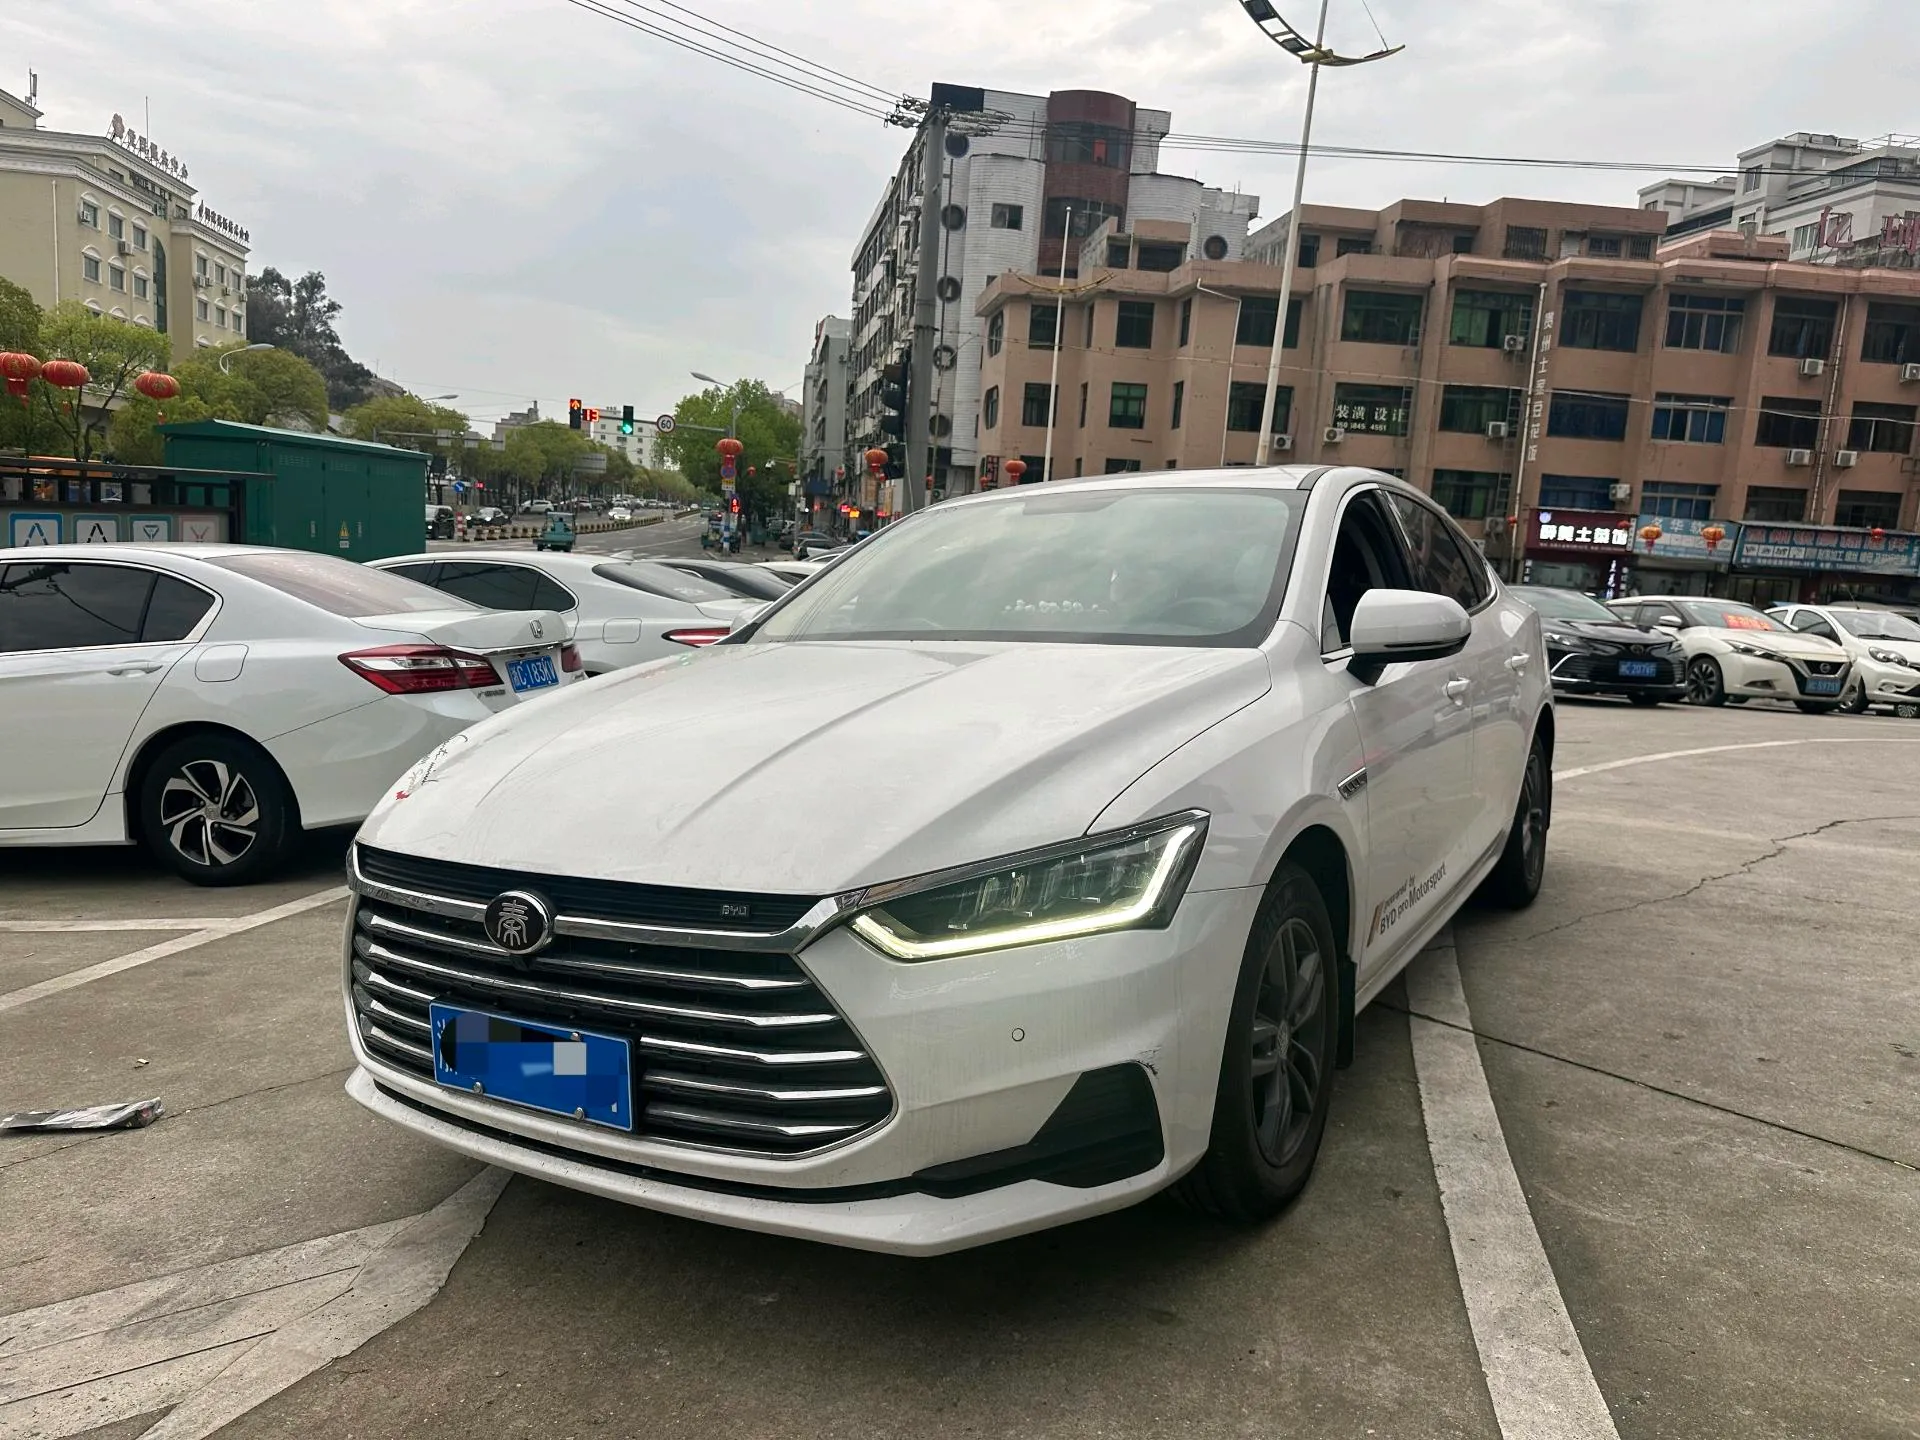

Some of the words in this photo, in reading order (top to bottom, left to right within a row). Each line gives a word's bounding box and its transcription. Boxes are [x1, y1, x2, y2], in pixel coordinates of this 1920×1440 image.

[586, 409, 599, 422] 13
[660, 419, 672, 430] 60
[1380, 908, 1397, 935] BYD
[1397, 899, 1409, 919] pro
[1408, 861, 1446, 909] Motorsport
[721, 904, 749, 918] BYD
[497, 899, 528, 947] 秦
